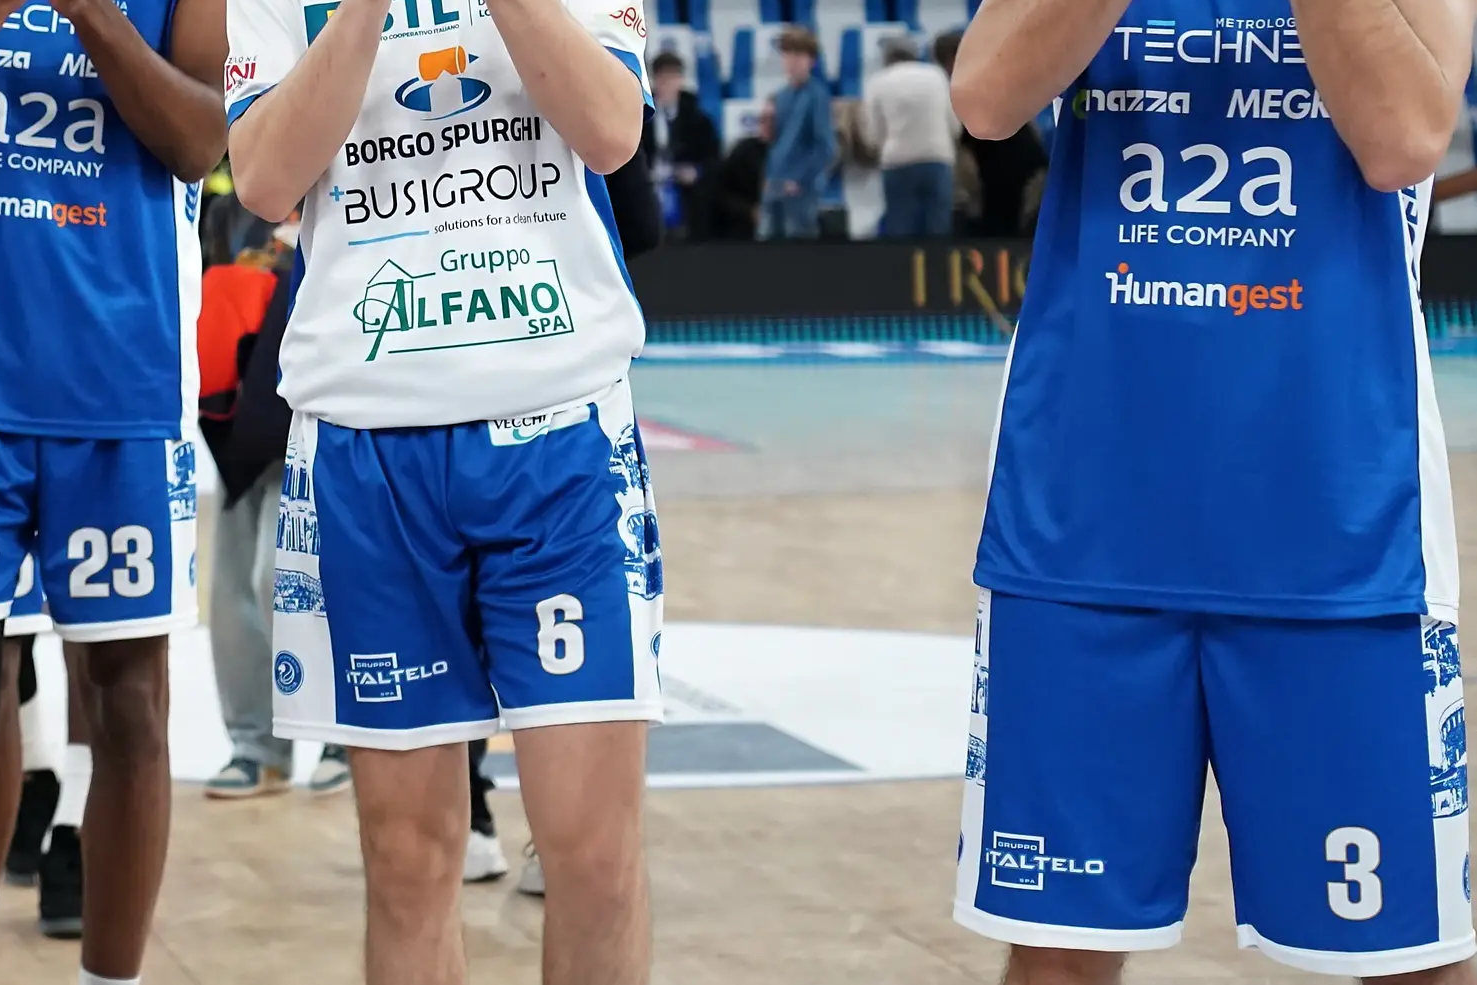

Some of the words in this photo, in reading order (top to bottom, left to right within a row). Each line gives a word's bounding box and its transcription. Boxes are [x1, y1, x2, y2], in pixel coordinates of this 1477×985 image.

[389, 30, 433, 40] COOPERATIVO
[433, 24, 460, 35] ITALIANO
[1216, 17, 1296, 29] METROLOG
[345, 131, 436, 166] BORGO
[441, 116, 541, 152] SPURGHI
[8, 153, 104, 179] COMPANY
[1118, 142, 1297, 217] a2a
[434, 217, 484, 234] solutions
[486, 215, 503, 226] for
[512, 213, 532, 224] clean
[533, 210, 567, 223] future
[1117, 223, 1159, 244] LIFE
[1167, 225, 1296, 247] COMPANY
[440, 247, 530, 274] Gruppo
[1105, 263, 1303, 315] Humangest
[353, 279, 559, 361] ALFANO
[528, 315, 567, 336] SPA
[67, 524, 155, 598] 23
[536, 592, 585, 675] 6
[356, 661, 392, 669] GRUPPO
[997, 841, 1038, 851] GRUPPO
[1325, 825, 1383, 921] 3
